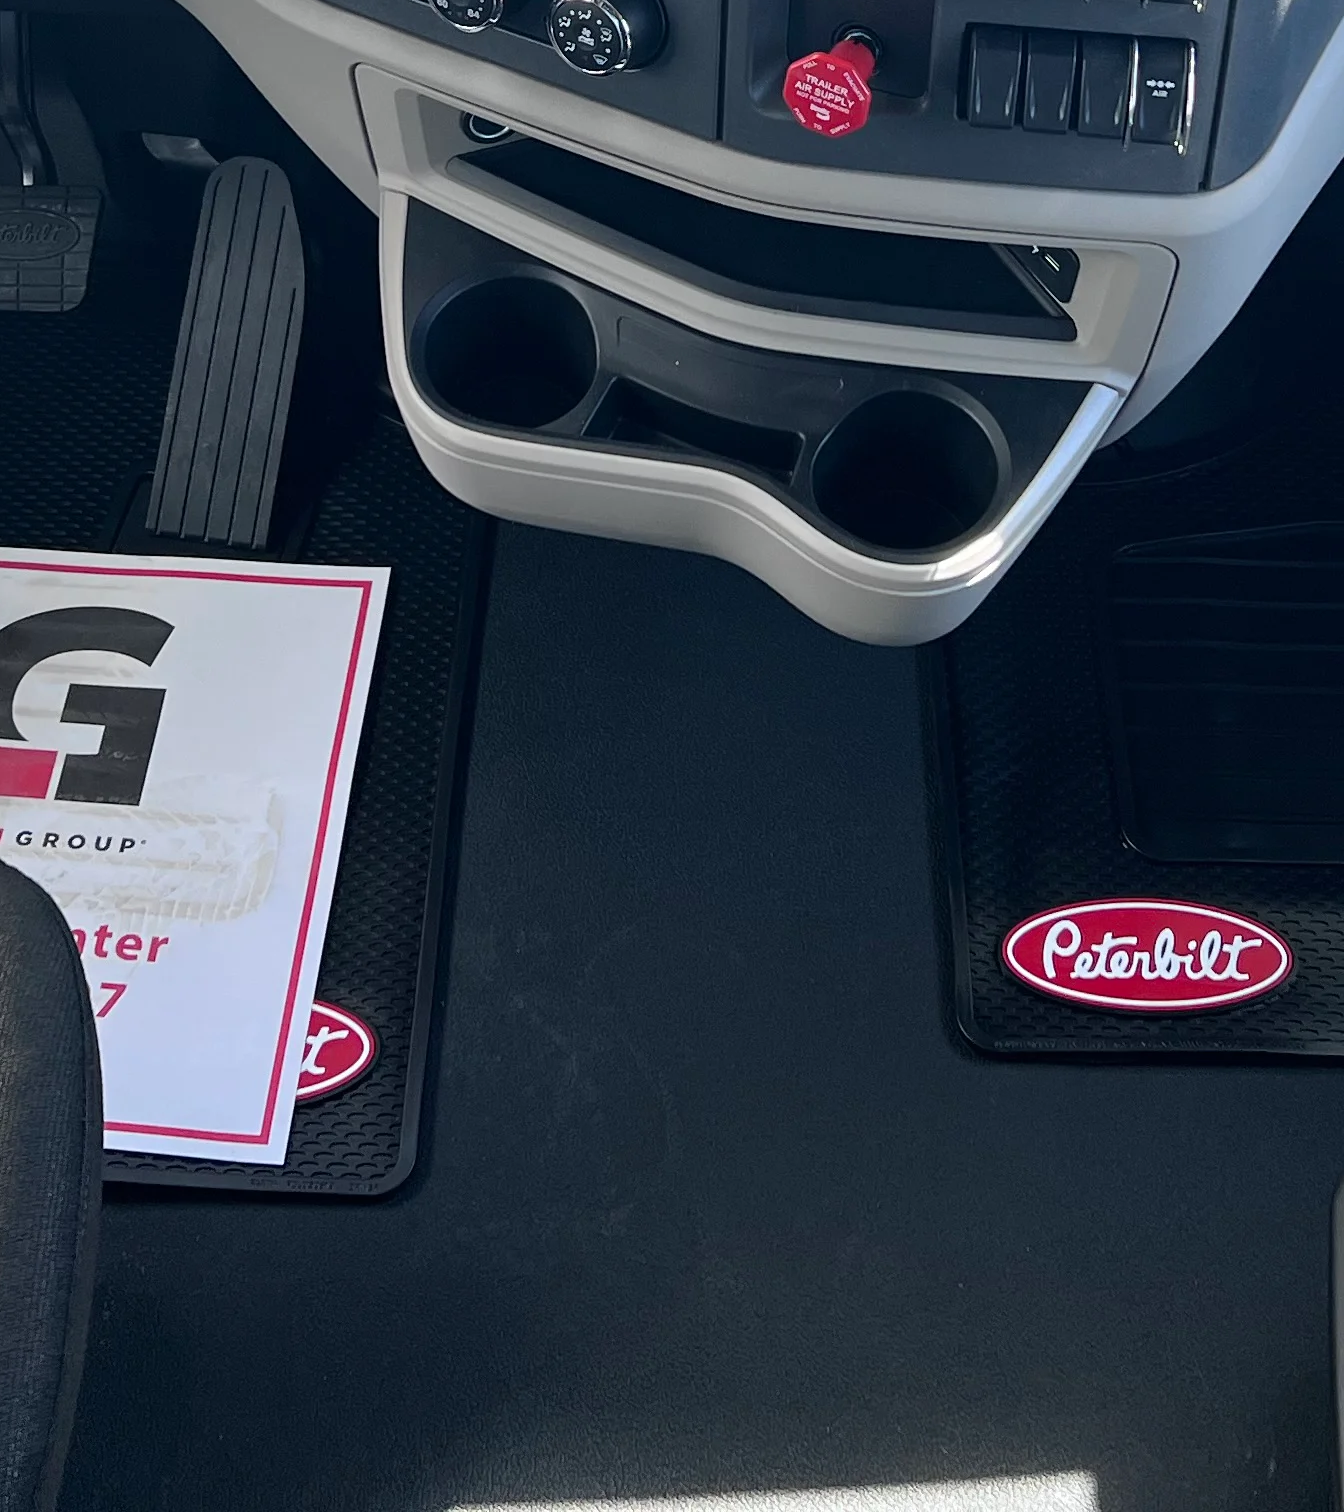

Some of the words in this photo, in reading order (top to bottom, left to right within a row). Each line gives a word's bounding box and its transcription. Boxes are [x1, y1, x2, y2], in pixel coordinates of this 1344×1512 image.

[826, 63, 836, 71] TO
[794, 80, 813, 94] AIR
[814, 87, 855, 109] SUPPLY
[805, 73, 849, 97] TRAILER
[796, 90, 810, 99] NOT
[809, 95, 823, 104] FOR
[822, 100, 850, 115] PARKING
[16, 830, 136, 853] GROUP
[70, 924, 169, 963] nter
[1041, 919, 1262, 981] Peterbilt
